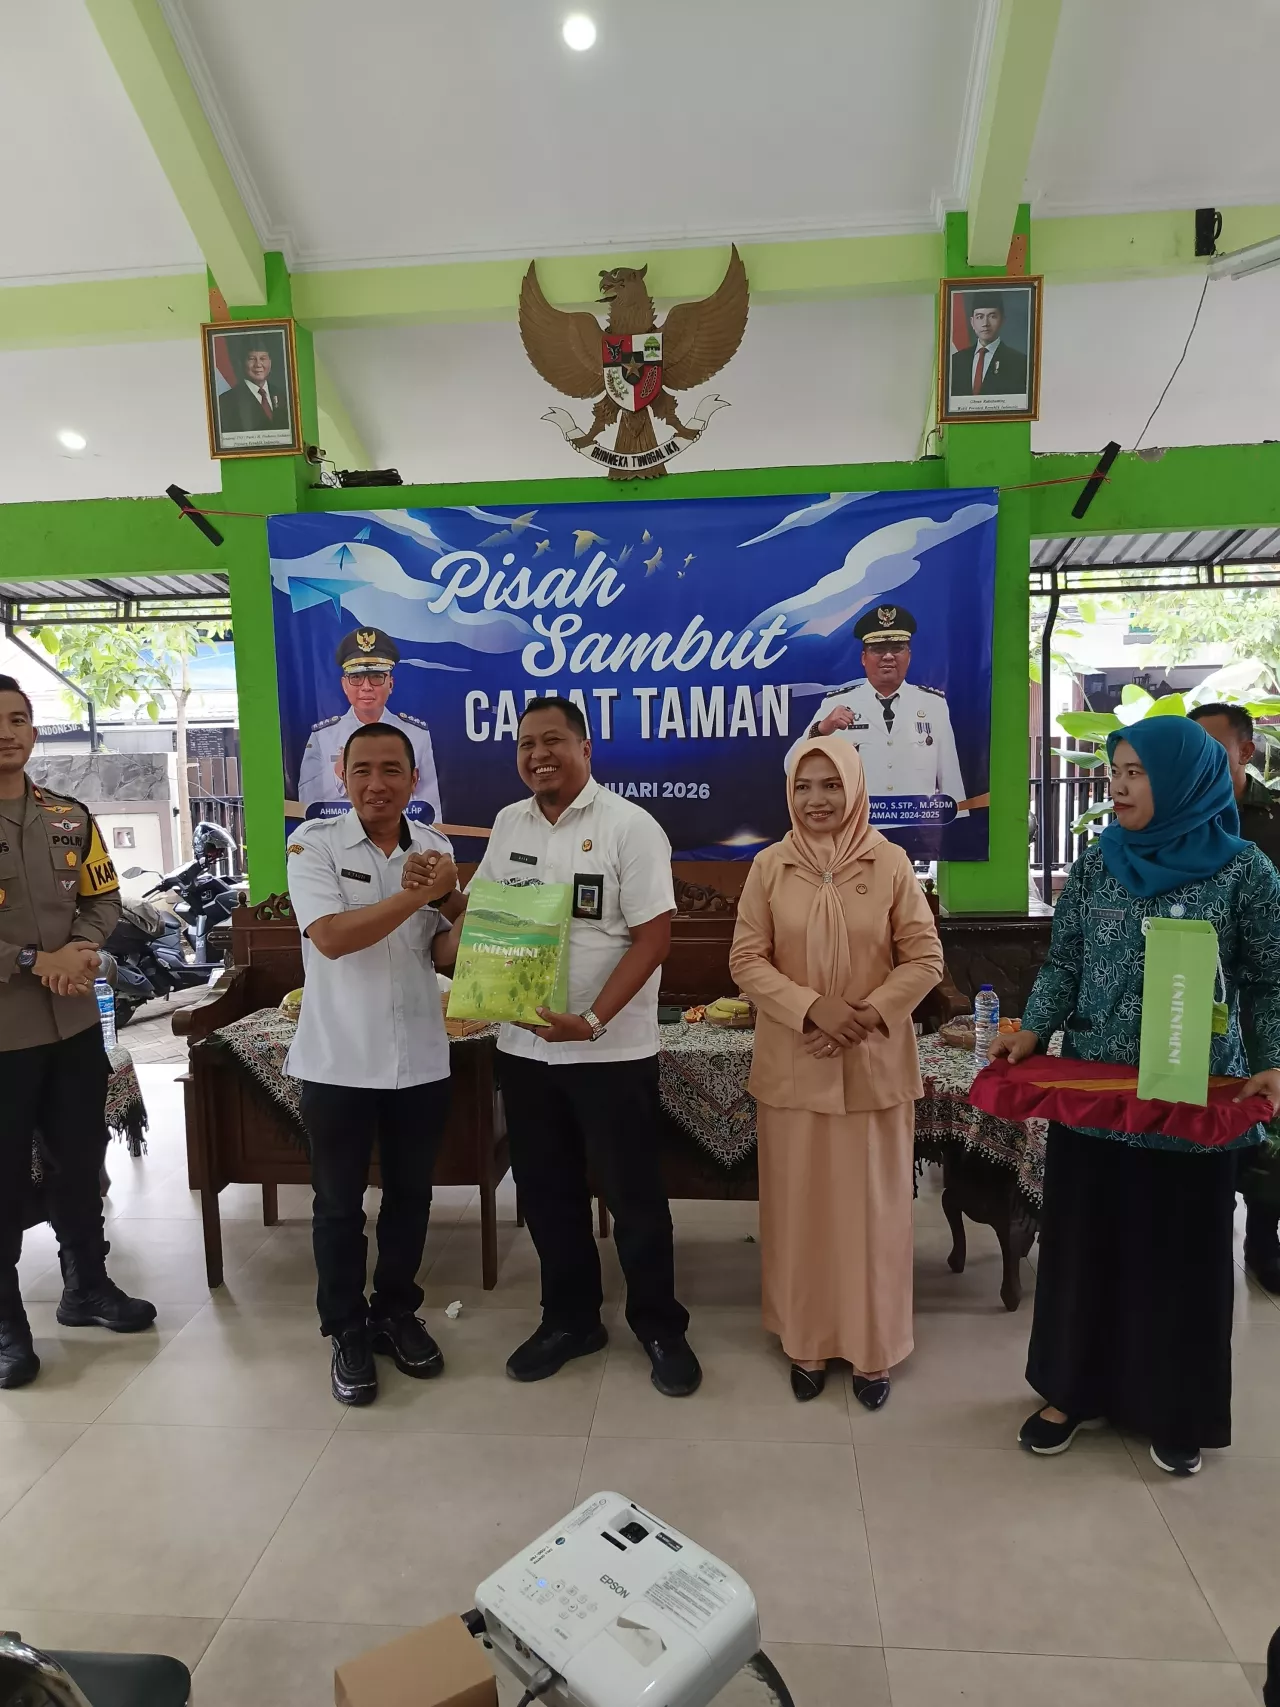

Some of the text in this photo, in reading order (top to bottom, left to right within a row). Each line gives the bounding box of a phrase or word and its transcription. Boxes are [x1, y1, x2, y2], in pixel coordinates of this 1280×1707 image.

[664, 440, 680, 456] IKA
[427, 550, 625, 614] Pisah
[521, 613, 789, 677] Sambut
[465, 684, 789, 741] CAAT TAMAN
[662, 781, 710, 799] 2026
[319, 807, 348, 815] AHMAD
[919, 801, 953, 809] M.PSDM
[869, 811, 940, 819] AMAN 2024-2025
[600, 1574, 630, 1599] EPSON
